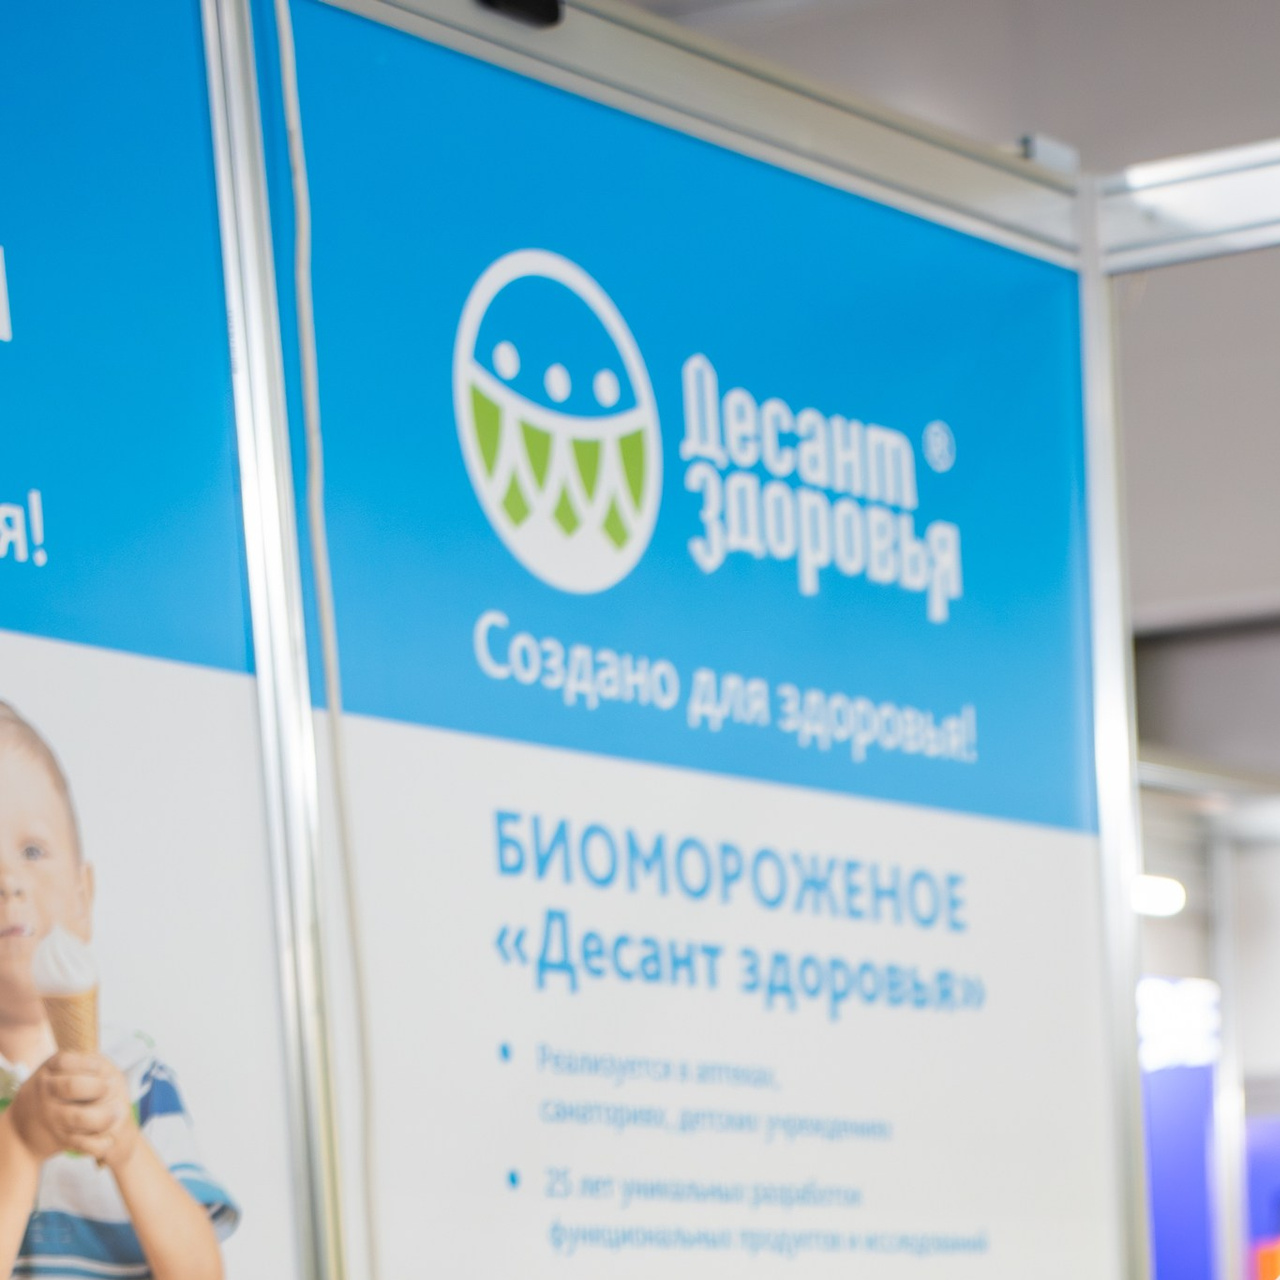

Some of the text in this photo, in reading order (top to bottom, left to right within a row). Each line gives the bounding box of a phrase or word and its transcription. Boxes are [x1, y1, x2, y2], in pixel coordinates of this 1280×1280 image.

[680, 353, 919, 511] Десант
[473, 609, 978, 763] Создано для здоровья!
[493, 808, 969, 934] БИОМОРОЖЕНОЕ
[494, 907, 985, 1024] «Десант здоровья»
